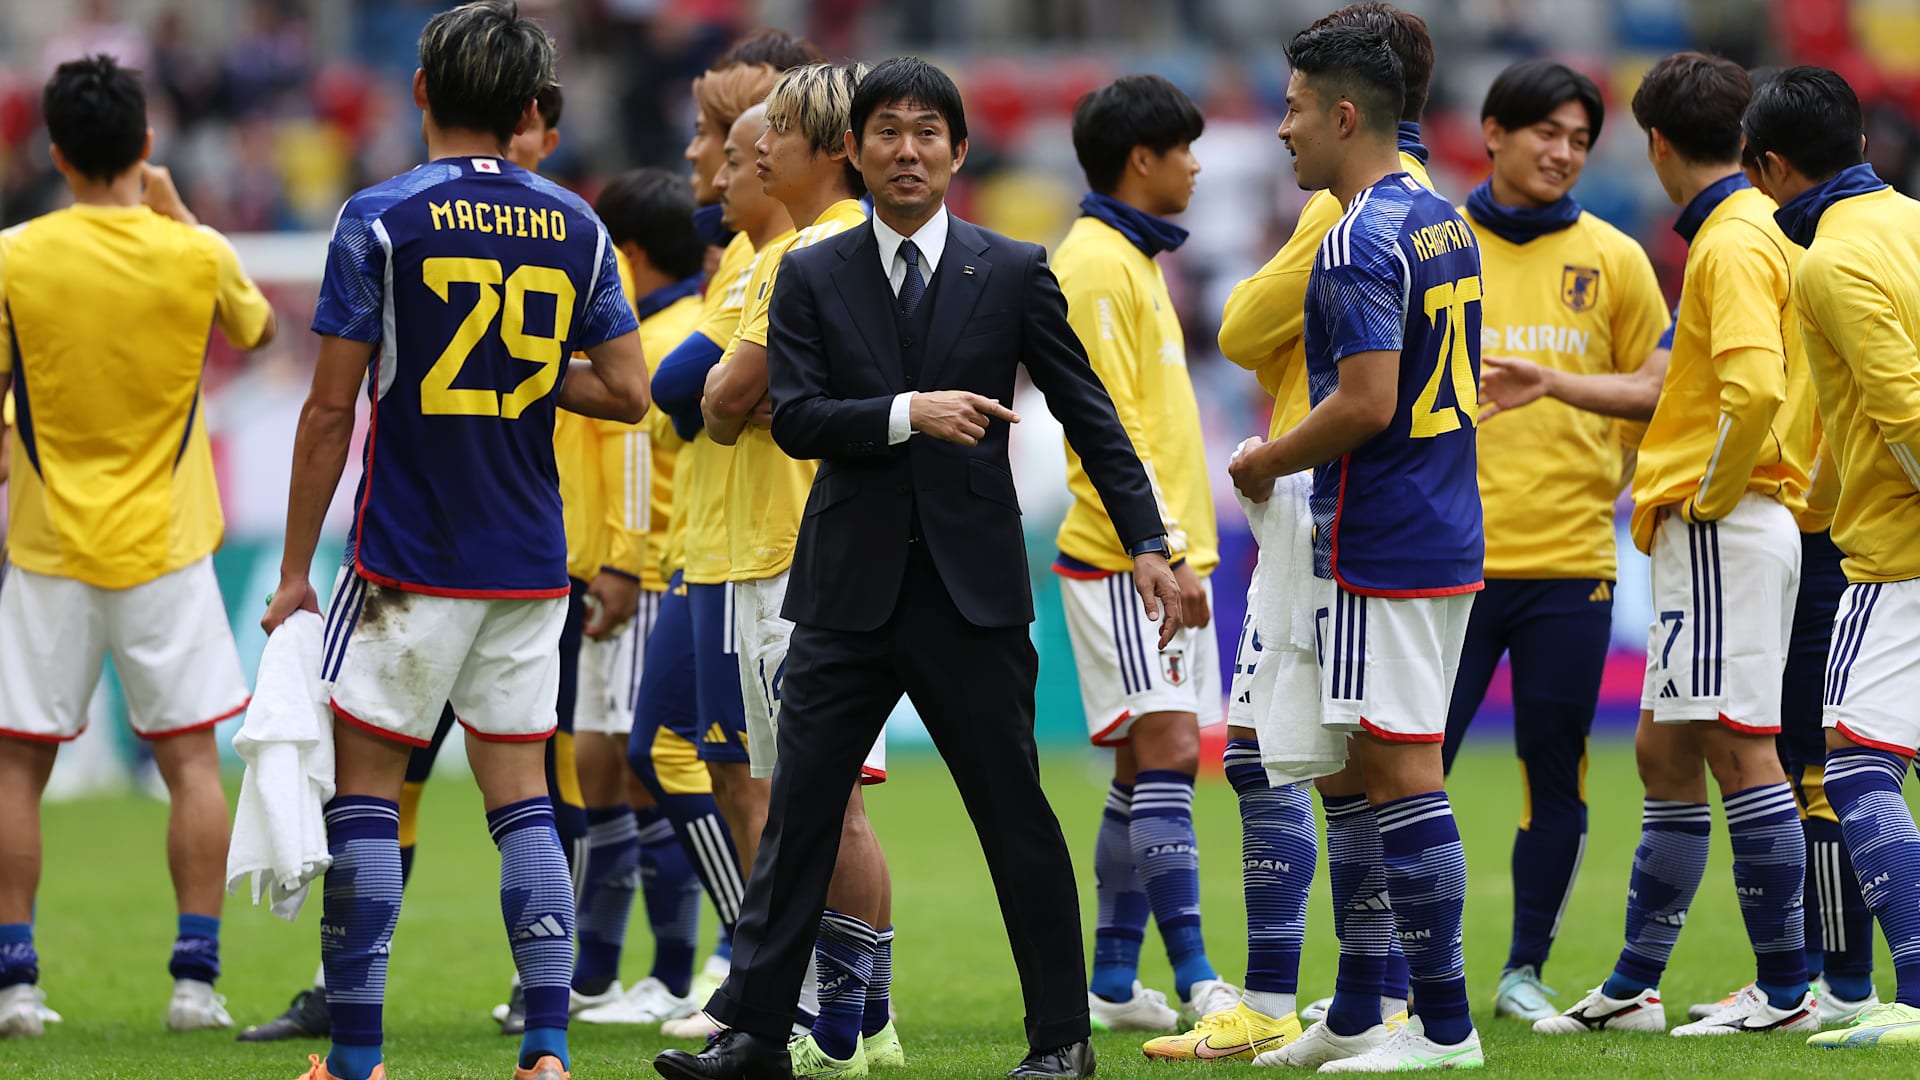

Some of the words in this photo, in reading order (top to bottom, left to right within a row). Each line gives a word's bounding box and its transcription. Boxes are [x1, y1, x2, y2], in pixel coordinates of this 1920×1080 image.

[429, 199, 567, 242] MACHINO
[420, 257, 577, 419] 29
[1505, 325, 1590, 356] KIRIN
[1660, 610, 1684, 670] 7
